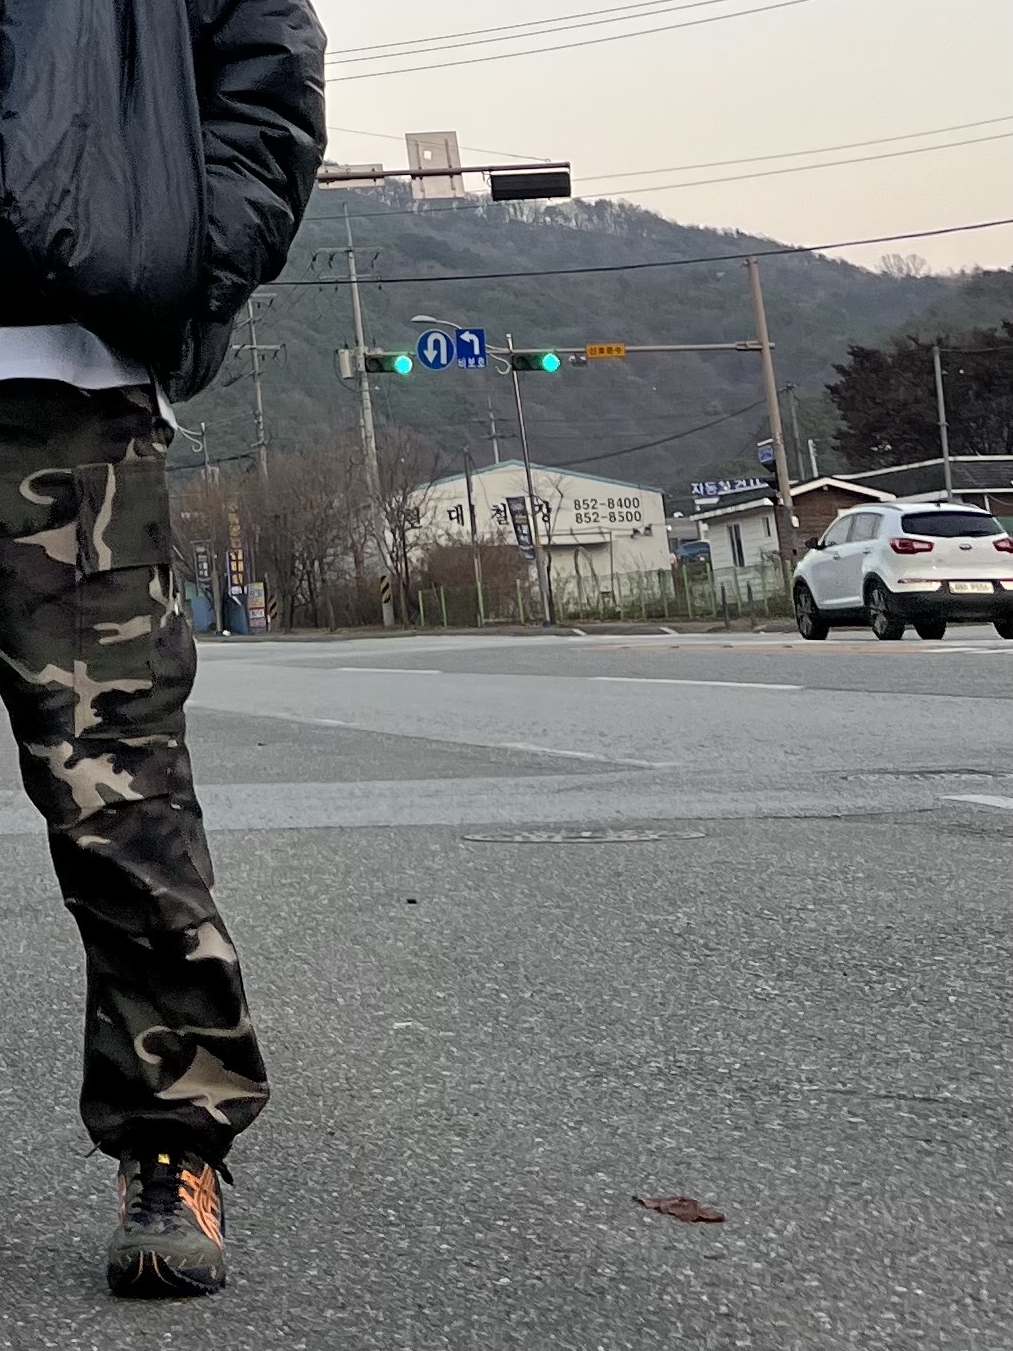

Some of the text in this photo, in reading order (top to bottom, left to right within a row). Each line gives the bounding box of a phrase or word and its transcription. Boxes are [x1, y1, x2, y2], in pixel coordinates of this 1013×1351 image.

[458, 356, 485, 369] 비보호
[574, 497, 640, 511] 852-8400
[575, 511, 642, 524] 852-8500
